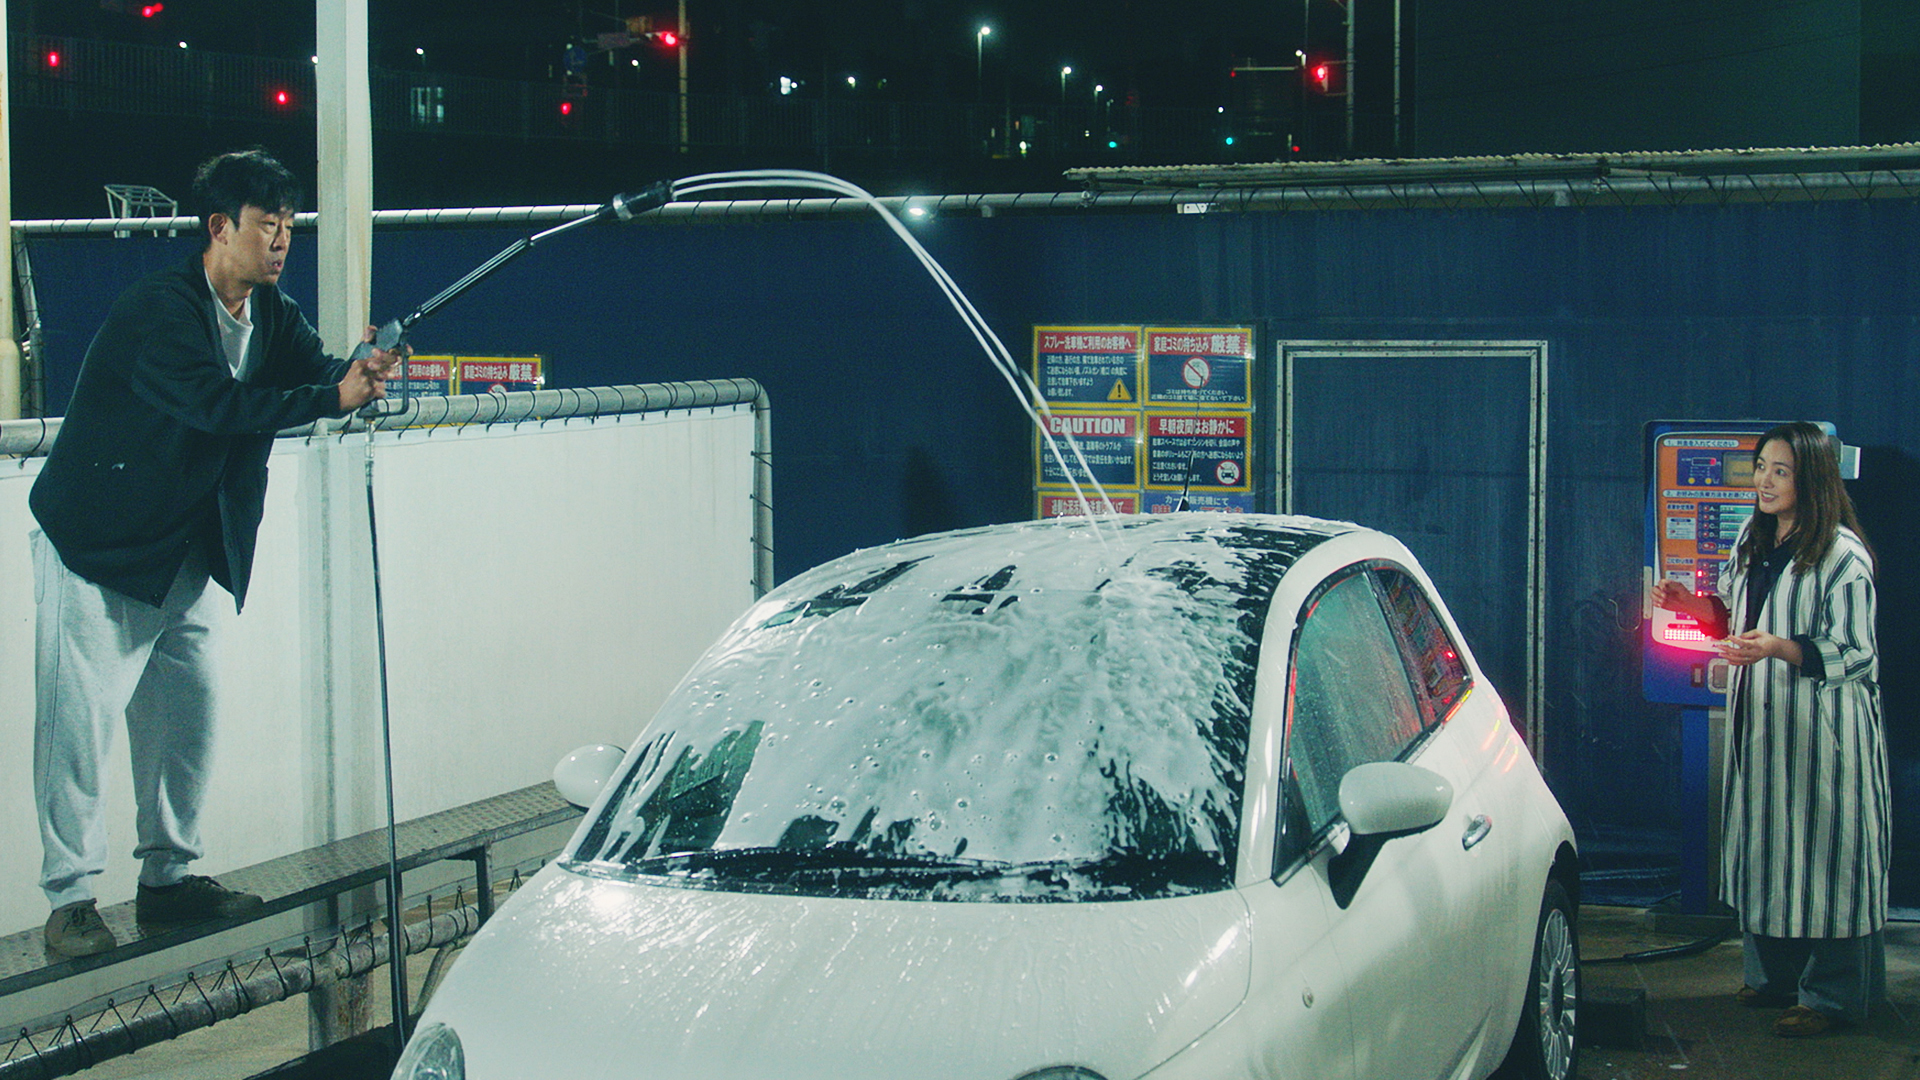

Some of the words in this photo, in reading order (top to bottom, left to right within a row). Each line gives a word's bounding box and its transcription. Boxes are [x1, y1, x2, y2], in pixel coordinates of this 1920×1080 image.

[1043, 336, 1132, 350] スプレー洗車機ご利用のお客様へ
[1153, 336, 1209, 353] 家庭ゴミの持ち込み
[1211, 334, 1241, 354] 厳禁
[509, 363, 533, 381] 厳禁
[1050, 417, 1126, 434] CAUTION
[1158, 418, 1235, 435] 早朝夜間はお静かに
[1165, 495, 1230, 506] カー販売機にて
